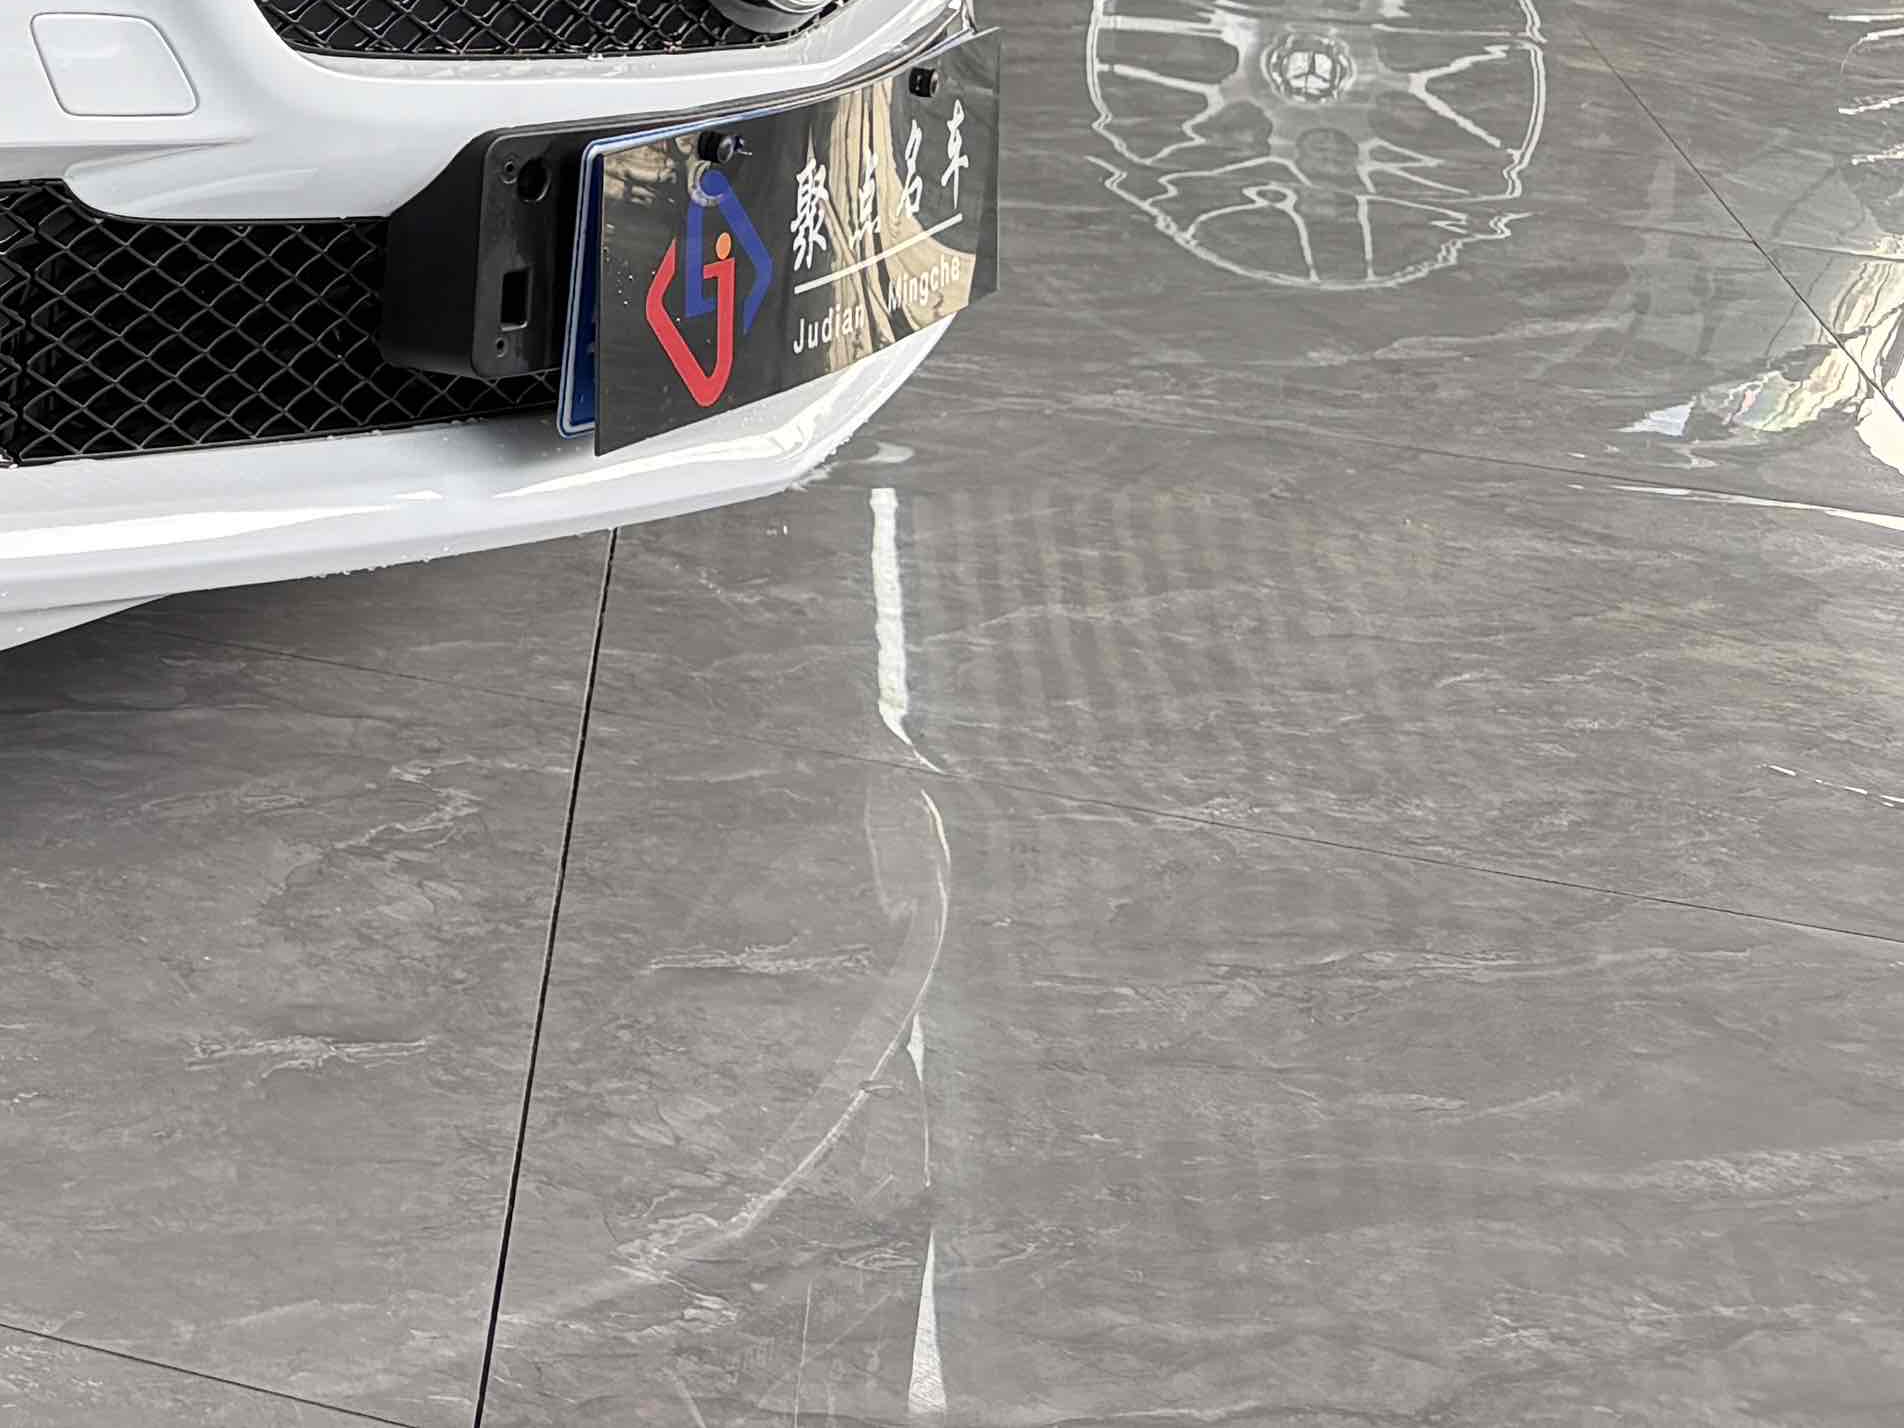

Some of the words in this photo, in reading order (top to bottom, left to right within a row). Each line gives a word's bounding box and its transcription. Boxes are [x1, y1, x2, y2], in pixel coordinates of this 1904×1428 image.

[790, 98, 969, 272] 聚点名车
[792, 302, 865, 355] Judian
[887, 254, 961, 314] Mingche
